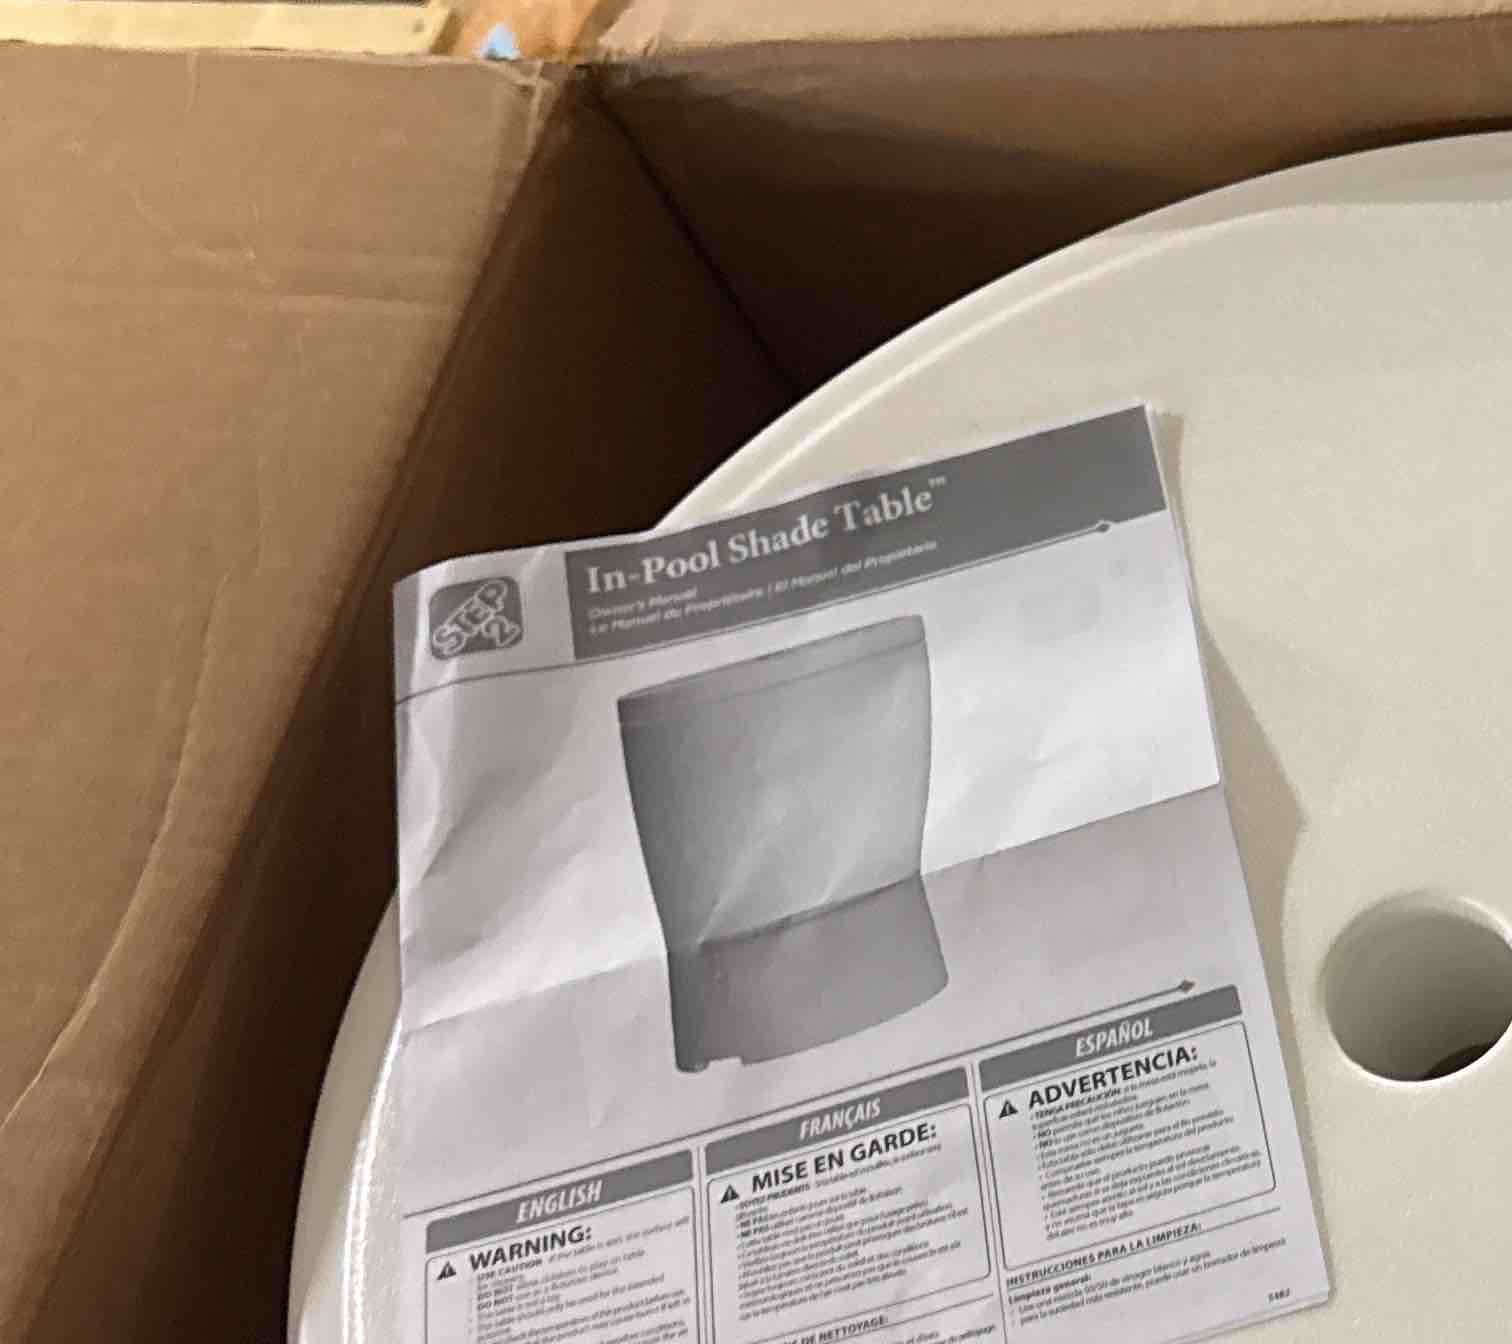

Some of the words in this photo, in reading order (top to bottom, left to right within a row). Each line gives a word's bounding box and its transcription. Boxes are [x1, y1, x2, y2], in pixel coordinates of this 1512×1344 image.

[586, 540, 720, 594] In-Pool
[728, 513, 830, 563] Shade
[1076, 1018, 1153, 1056] ESPAÑOL
[1029, 1045, 1198, 1109] ADVERTENCIA:
[800, 1098, 881, 1140] FRANÇAIS
[752, 1160, 807, 1193] MISE
[814, 1149, 844, 1175] EN
[850, 1123, 937, 1162] GARDE:
[516, 1179, 603, 1224] ENGLISH
[469, 1225, 592, 1272] WARNING:
